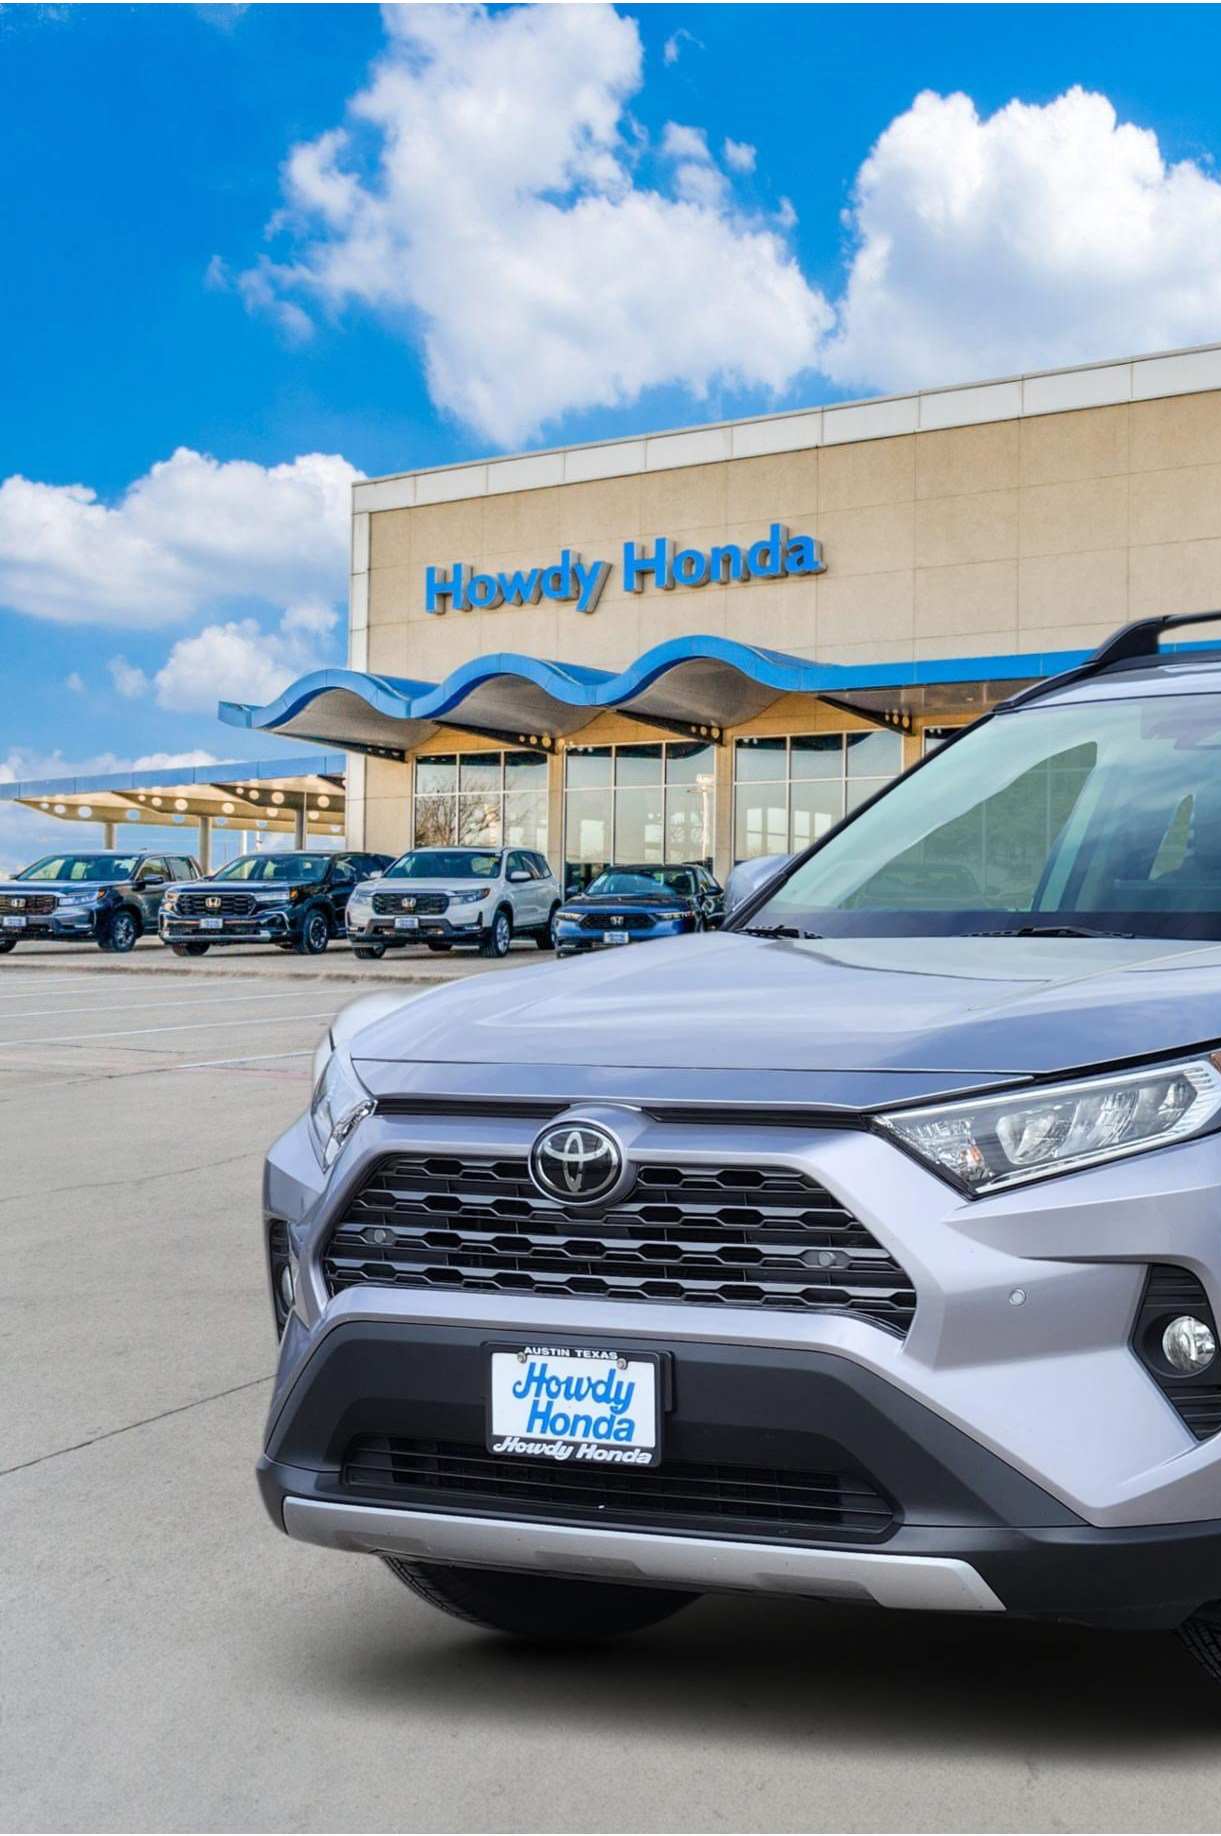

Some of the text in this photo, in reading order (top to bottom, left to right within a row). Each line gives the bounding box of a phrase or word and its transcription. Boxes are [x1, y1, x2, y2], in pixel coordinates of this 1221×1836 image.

[425, 523, 828, 614] Howdy Honda
[524, 1346, 618, 1360] AUSTIN TEXAS
[512, 1362, 635, 1415] Howdy
[527, 1399, 635, 1442] Honda
[493, 1437, 652, 1464] Howdy Honda
